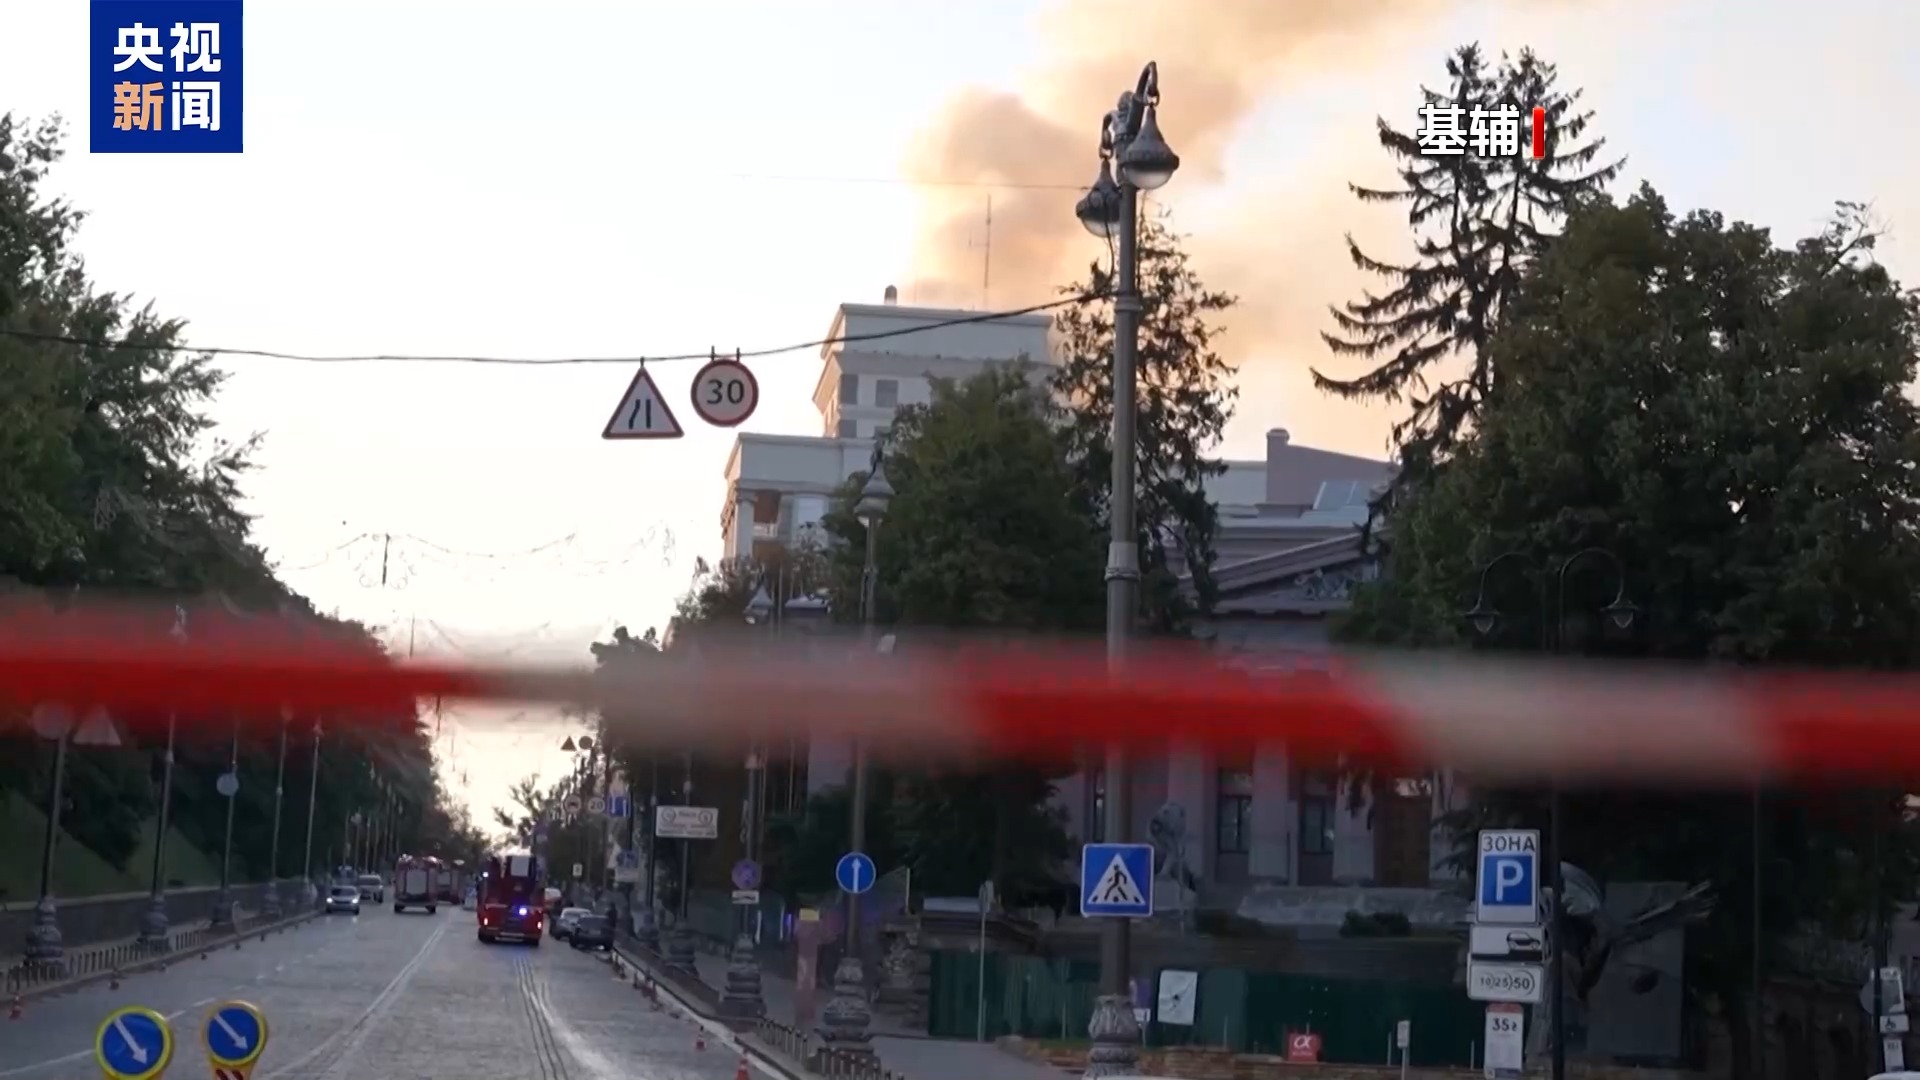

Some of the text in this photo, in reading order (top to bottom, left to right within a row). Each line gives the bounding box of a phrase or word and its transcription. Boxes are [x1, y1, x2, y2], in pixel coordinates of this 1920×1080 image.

[707, 378, 745, 405] 30
[589, 800, 604, 812] 20
[1482, 835, 1536, 853] ЗОНА
[1495, 859, 1524, 902] P
